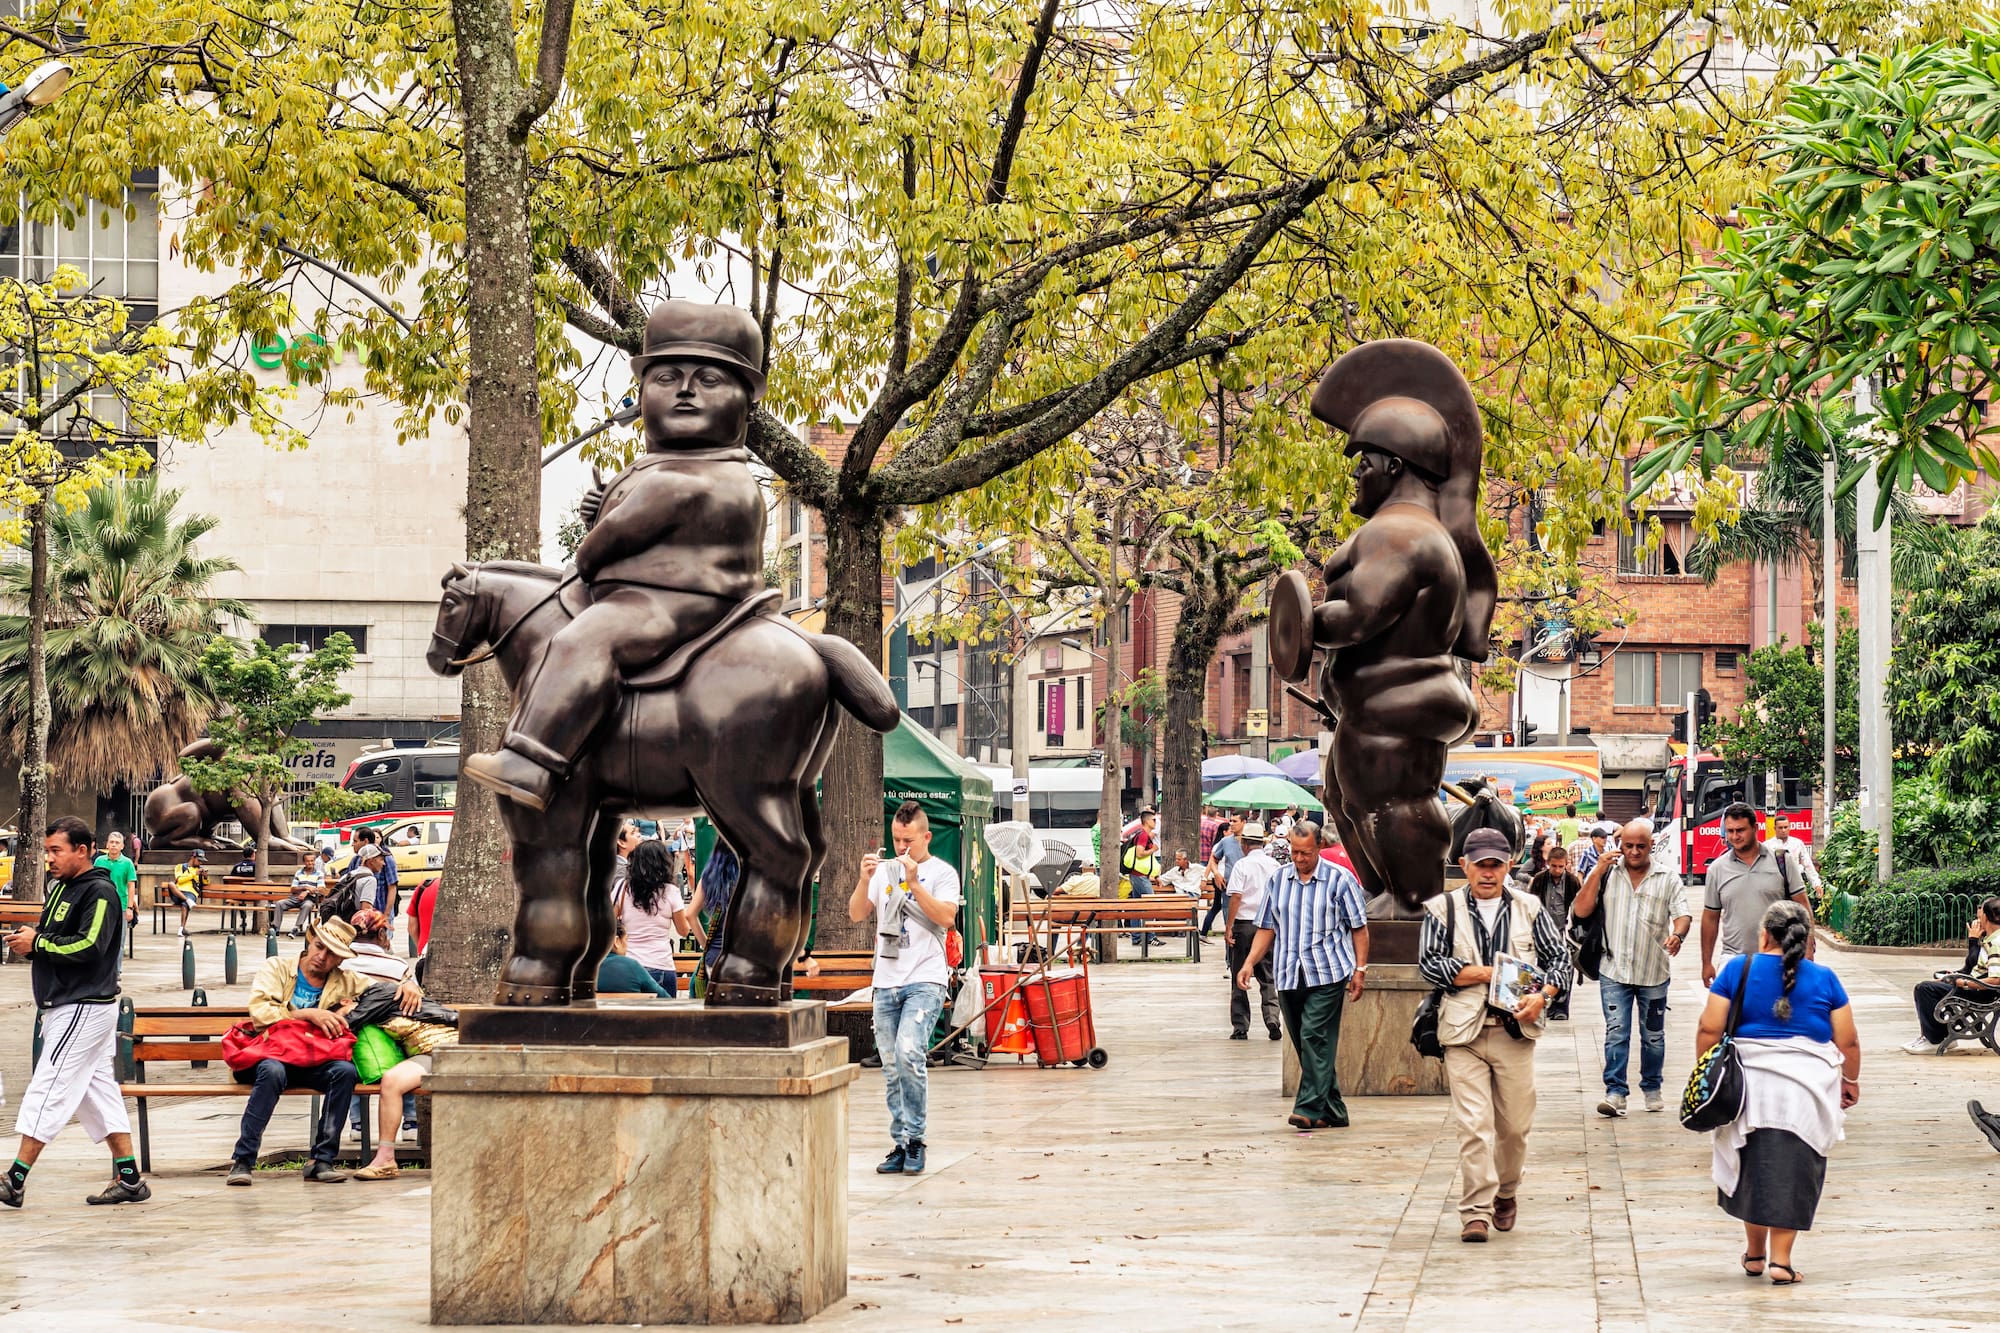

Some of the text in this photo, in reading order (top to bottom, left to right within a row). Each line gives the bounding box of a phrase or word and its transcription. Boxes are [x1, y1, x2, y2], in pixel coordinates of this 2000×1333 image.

[1537, 648, 1571, 658] SHOW
[888, 790, 897, 798] tú
[898, 790, 928, 799] quieres
